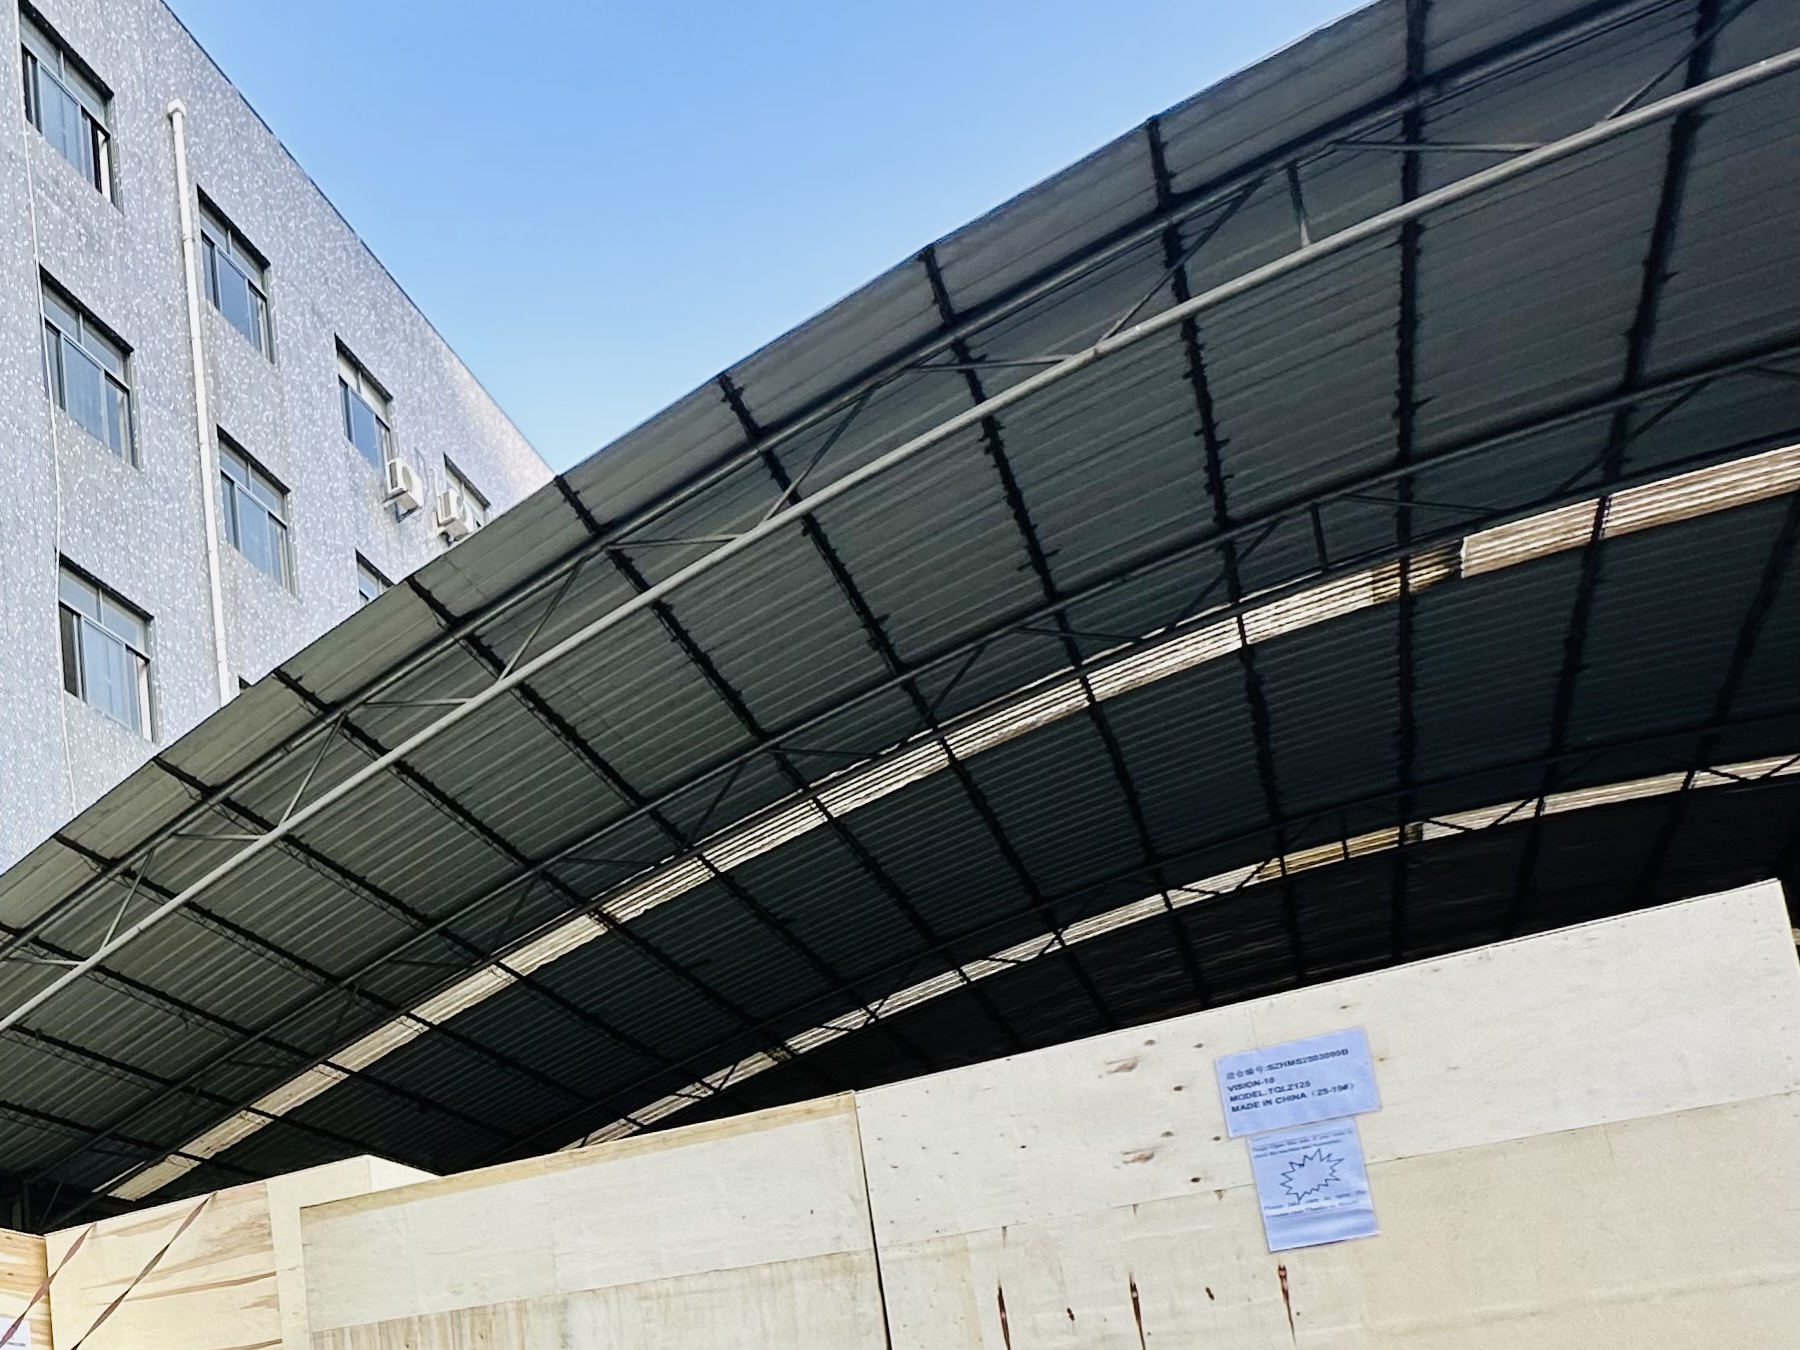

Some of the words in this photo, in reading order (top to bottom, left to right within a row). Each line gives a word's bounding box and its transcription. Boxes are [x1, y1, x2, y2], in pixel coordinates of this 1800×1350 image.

[1231, 1101, 1261, 1113] MADE
[1263, 1098, 1273, 1107] IN
[1275, 1092, 1307, 1105] CHINA
